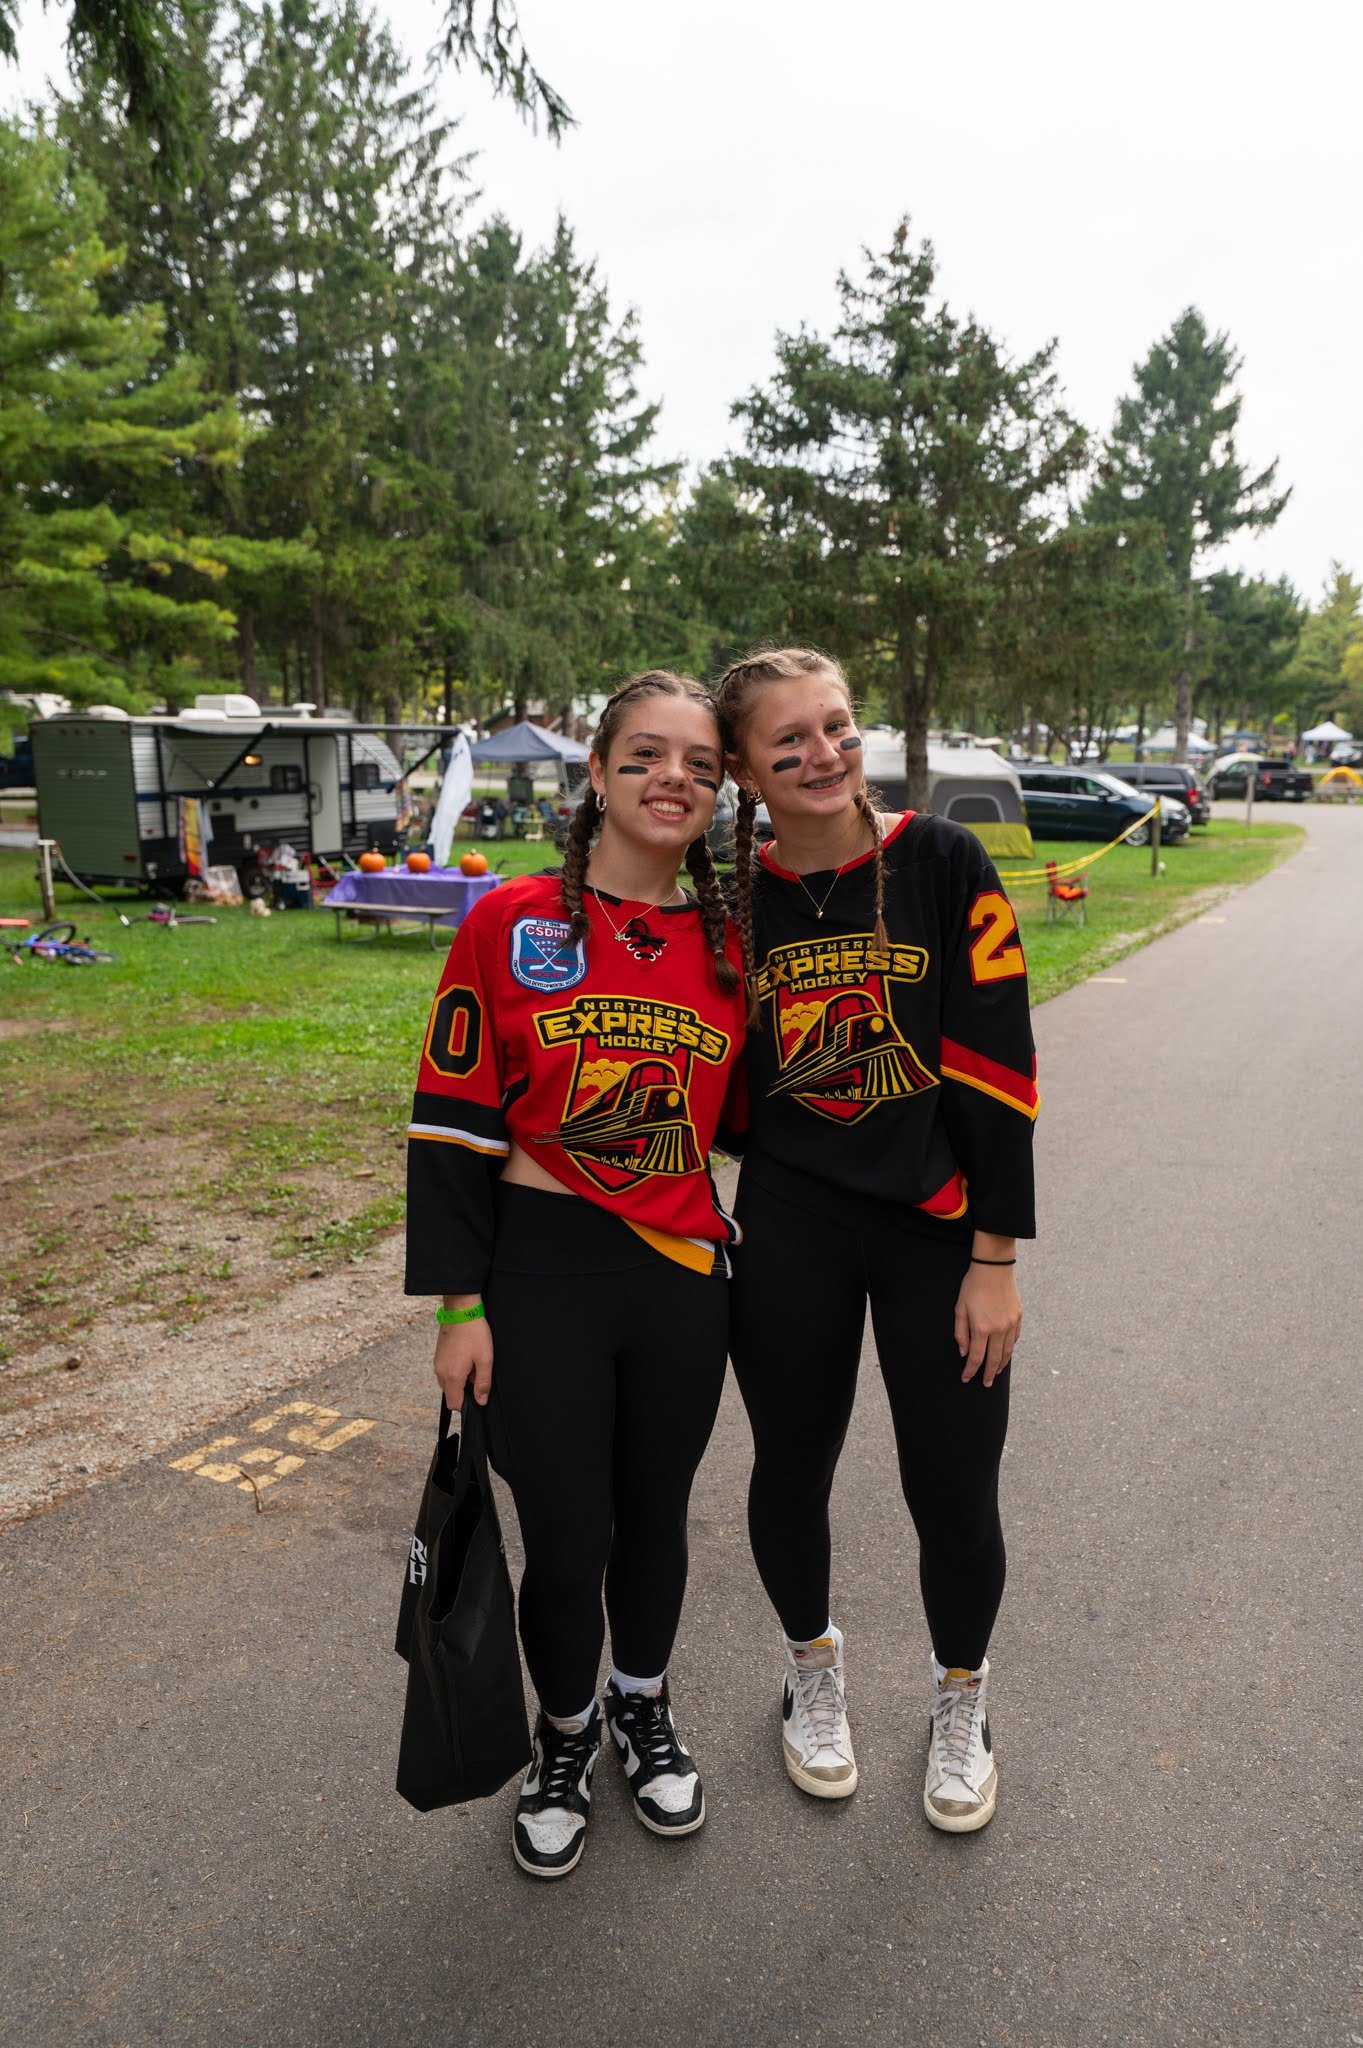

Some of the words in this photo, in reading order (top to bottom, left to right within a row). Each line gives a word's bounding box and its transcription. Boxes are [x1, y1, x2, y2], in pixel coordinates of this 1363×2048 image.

[968, 890, 1027, 985] 2
[757, 950, 920, 991] EXPRESS
[791, 972, 868, 993] HOCKEY
[425, 984, 483, 1079] 0
[583, 1001, 690, 1023] NORTHERN
[544, 1011, 723, 1057] EXPRESS
[600, 1035, 679, 1055] HOCKEY
